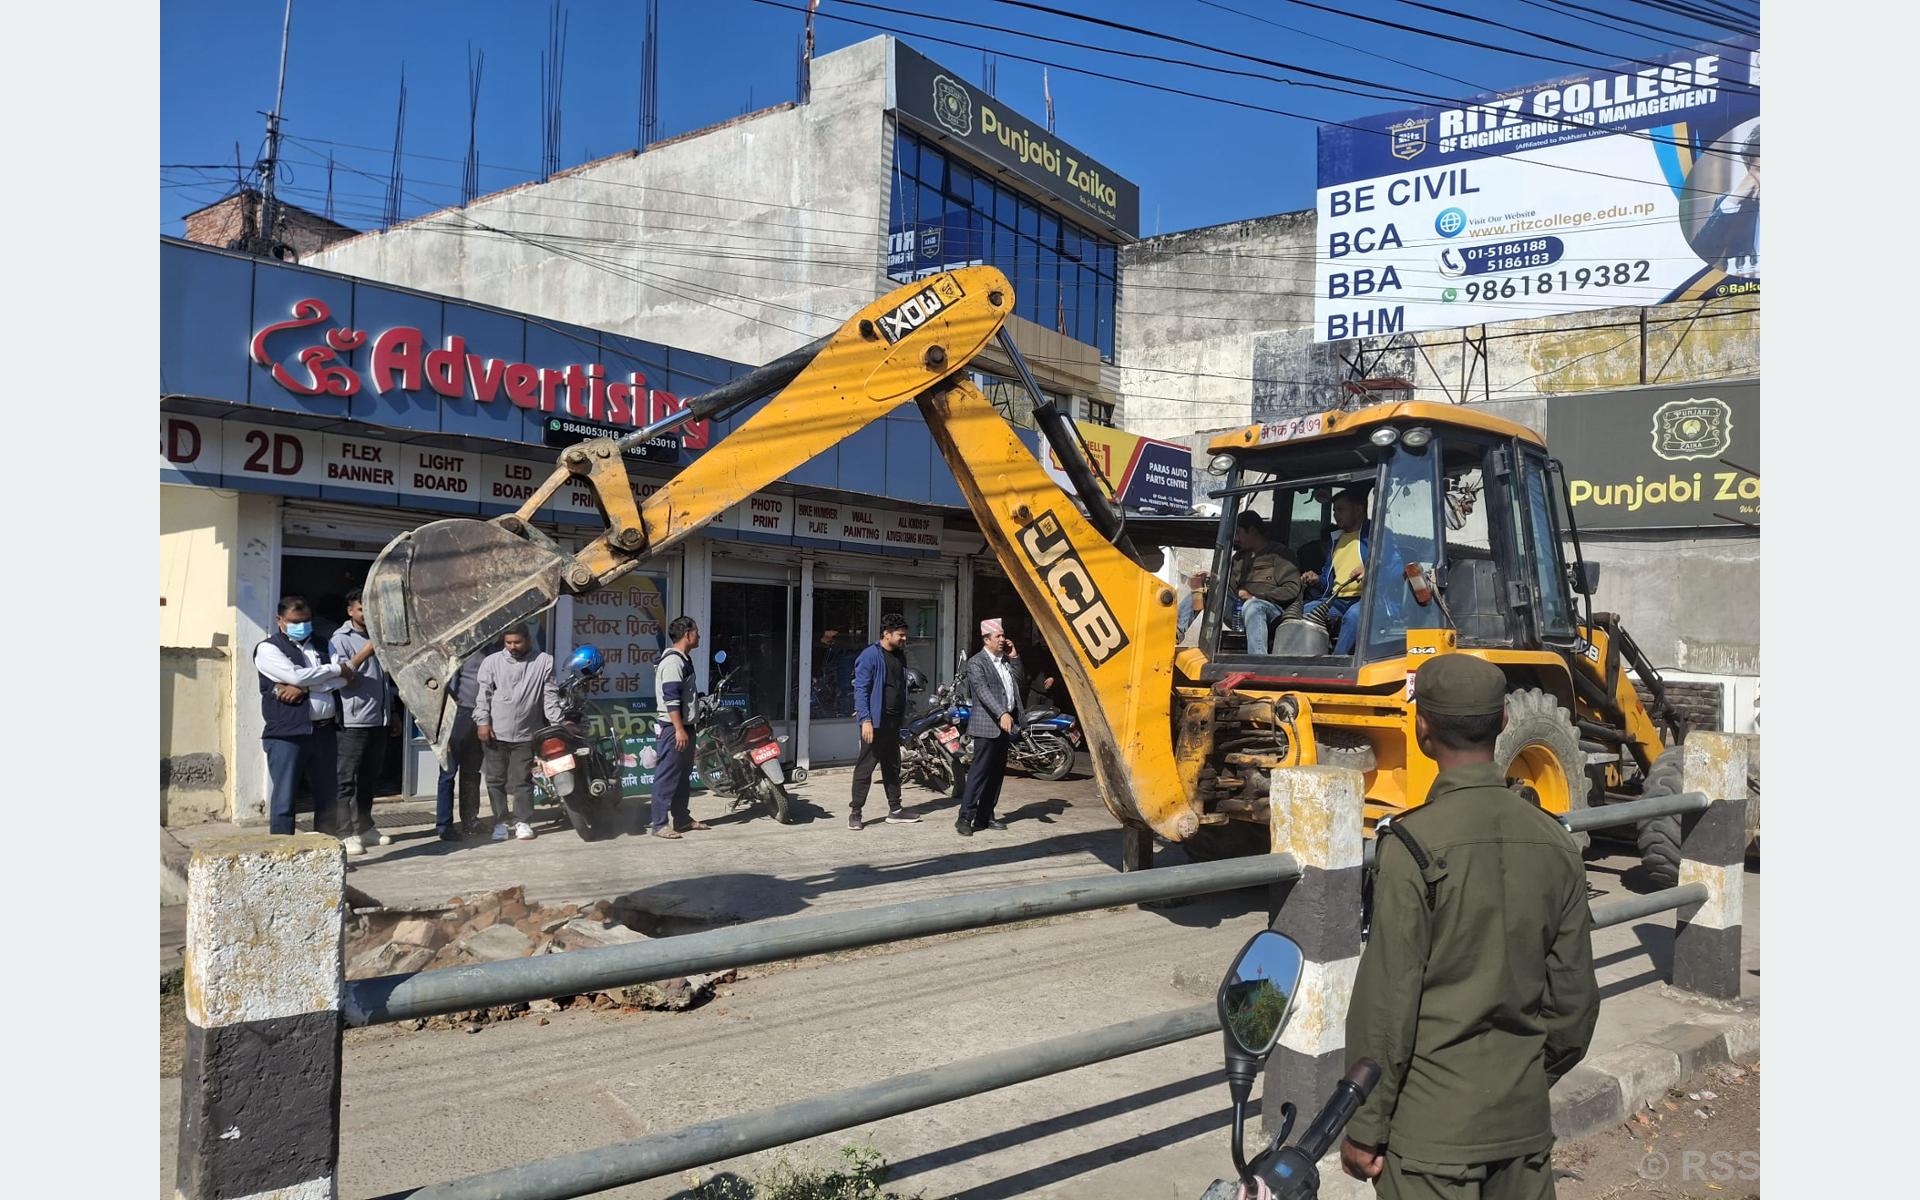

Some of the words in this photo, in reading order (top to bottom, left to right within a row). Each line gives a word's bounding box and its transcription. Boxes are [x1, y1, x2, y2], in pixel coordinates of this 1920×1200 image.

[1440, 95, 1524, 138] RITZ
[1533, 54, 1719, 119] COLLEGE
[1439, 136, 1457, 154] OF
[1460, 118, 1559, 150] ENGINEERING
[1561, 112, 1595, 132] AND
[1599, 87, 1717, 125] MANAGEMENT
[1558, 133, 1587, 142] Pokhara
[981, 105, 1061, 177] Punjabi
[1066, 156, 1117, 208] Zaika
[1330, 185, 1375, 218] BE
[1388, 168, 1480, 206] CIVIL
[1469, 216, 1486, 226] Visit
[1488, 214, 1503, 223] Our
[1504, 209, 1536, 220] Website
[1469, 201, 1656, 239] www.ritzcollege.edu.np
[1329, 223, 1404, 259] BCA
[1467, 239, 1548, 261] 01-5186188
[1487, 253, 1550, 272] 5186183
[1328, 265, 1403, 300] BBA
[1465, 260, 1651, 303] 9861819382
[1327, 306, 1405, 341] BHM
[370, 326, 711, 450] Advertising
[160, 419, 202, 464] D
[562, 422, 619, 440] 9848053018
[243, 430, 304, 475] 2D
[342, 442, 382, 463] FLEX
[419, 453, 464, 473] LIGHT
[327, 463, 394, 486] BANNER
[505, 464, 532, 480] LED
[1149, 462, 1169, 475] PARAS
[1171, 467, 1188, 479] AUTO
[413, 473, 468, 494] BOARD
[1145, 473, 1165, 486] PARTS
[1166, 476, 1188, 490] CENTRE
[1570, 472, 1702, 511] Punjabi
[1714, 472, 1760, 501] Za
[751, 497, 782, 513] PHOTO
[753, 514, 779, 529] PRINT
[808, 521, 828, 534] PLATE
[852, 511, 874, 525] WALL
[897, 517, 907, 528] ALL
[843, 525, 880, 540] PAINTING
[1023, 526, 1122, 661] JCB
